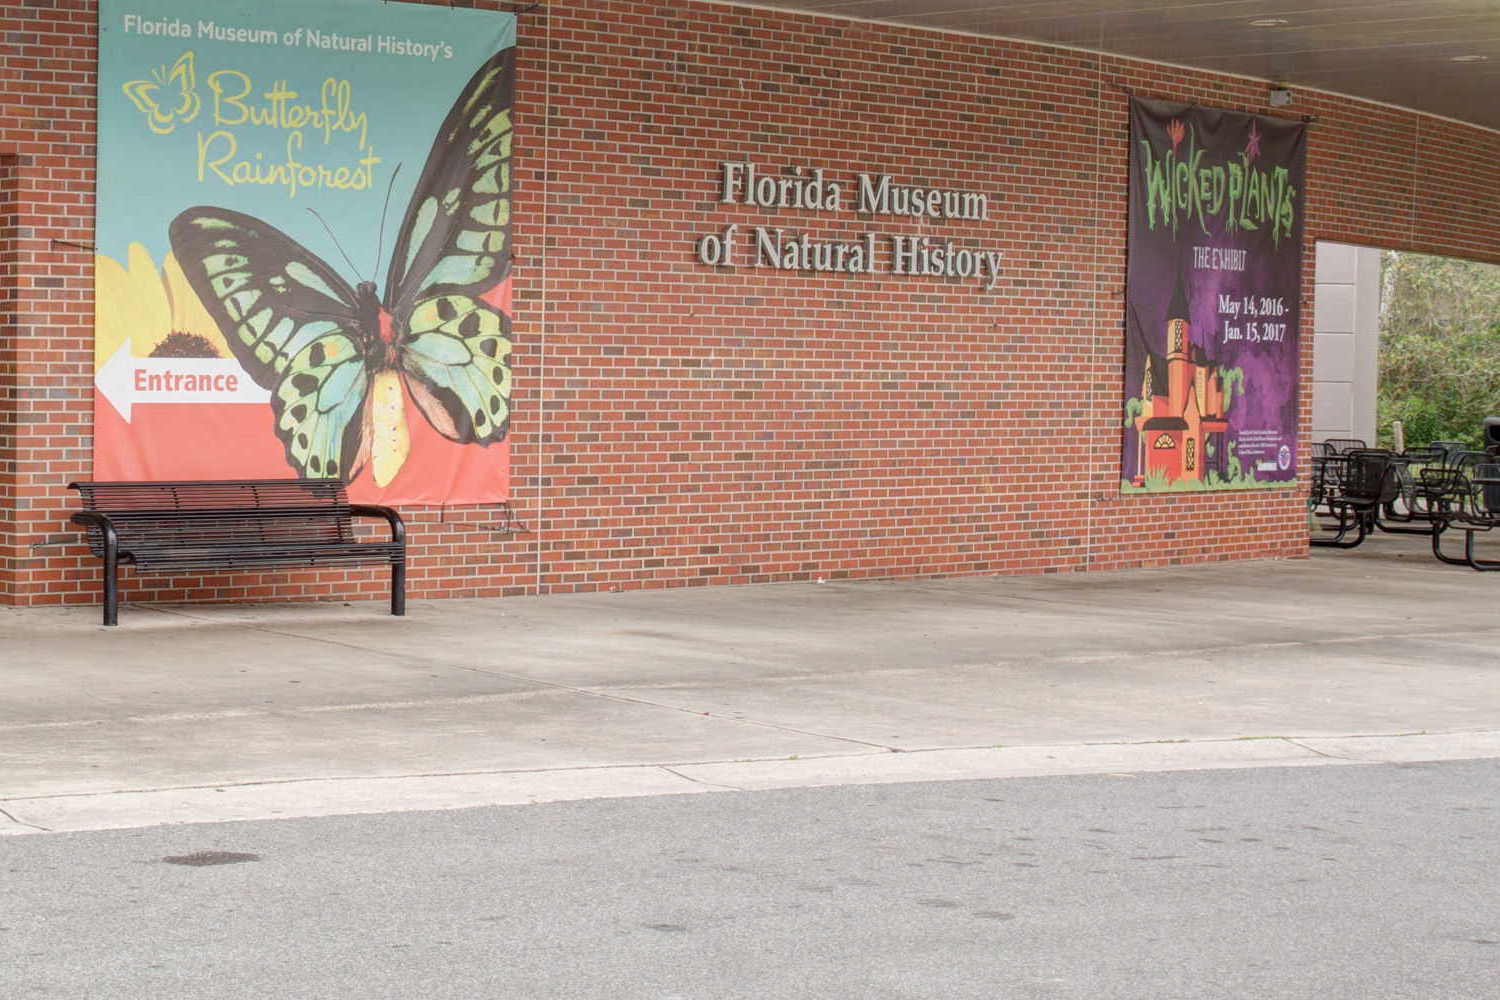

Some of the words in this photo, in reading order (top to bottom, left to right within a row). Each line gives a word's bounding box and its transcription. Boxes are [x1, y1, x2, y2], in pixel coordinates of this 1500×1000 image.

[123, 13, 192, 40] Florida
[197, 20, 278, 46] Museum
[282, 28, 303, 48] of
[305, 28, 373, 54] Natural
[376, 34, 454, 62] History's
[206, 69, 368, 150] Butterfly
[197, 130, 382, 199] Rainforest
[722, 162, 842, 212] Florida
[858, 173, 990, 220] Museum
[698, 224, 739, 266] of
[754, 226, 877, 273] Natural
[891, 233, 1005, 291] History
[1193, 246, 1210, 269] THE
[1212, 248, 1247, 272] EXHIBIT
[1218, 294, 1241, 319] May
[1243, 295, 1258, 318] 14,
[1259, 297, 1284, 316] 2016
[1222, 320, 1243, 345] Jan.
[1244, 322, 1261, 343] 15,
[1262, 323, 1287, 342] 2017
[133, 367, 239, 393] Entrance
